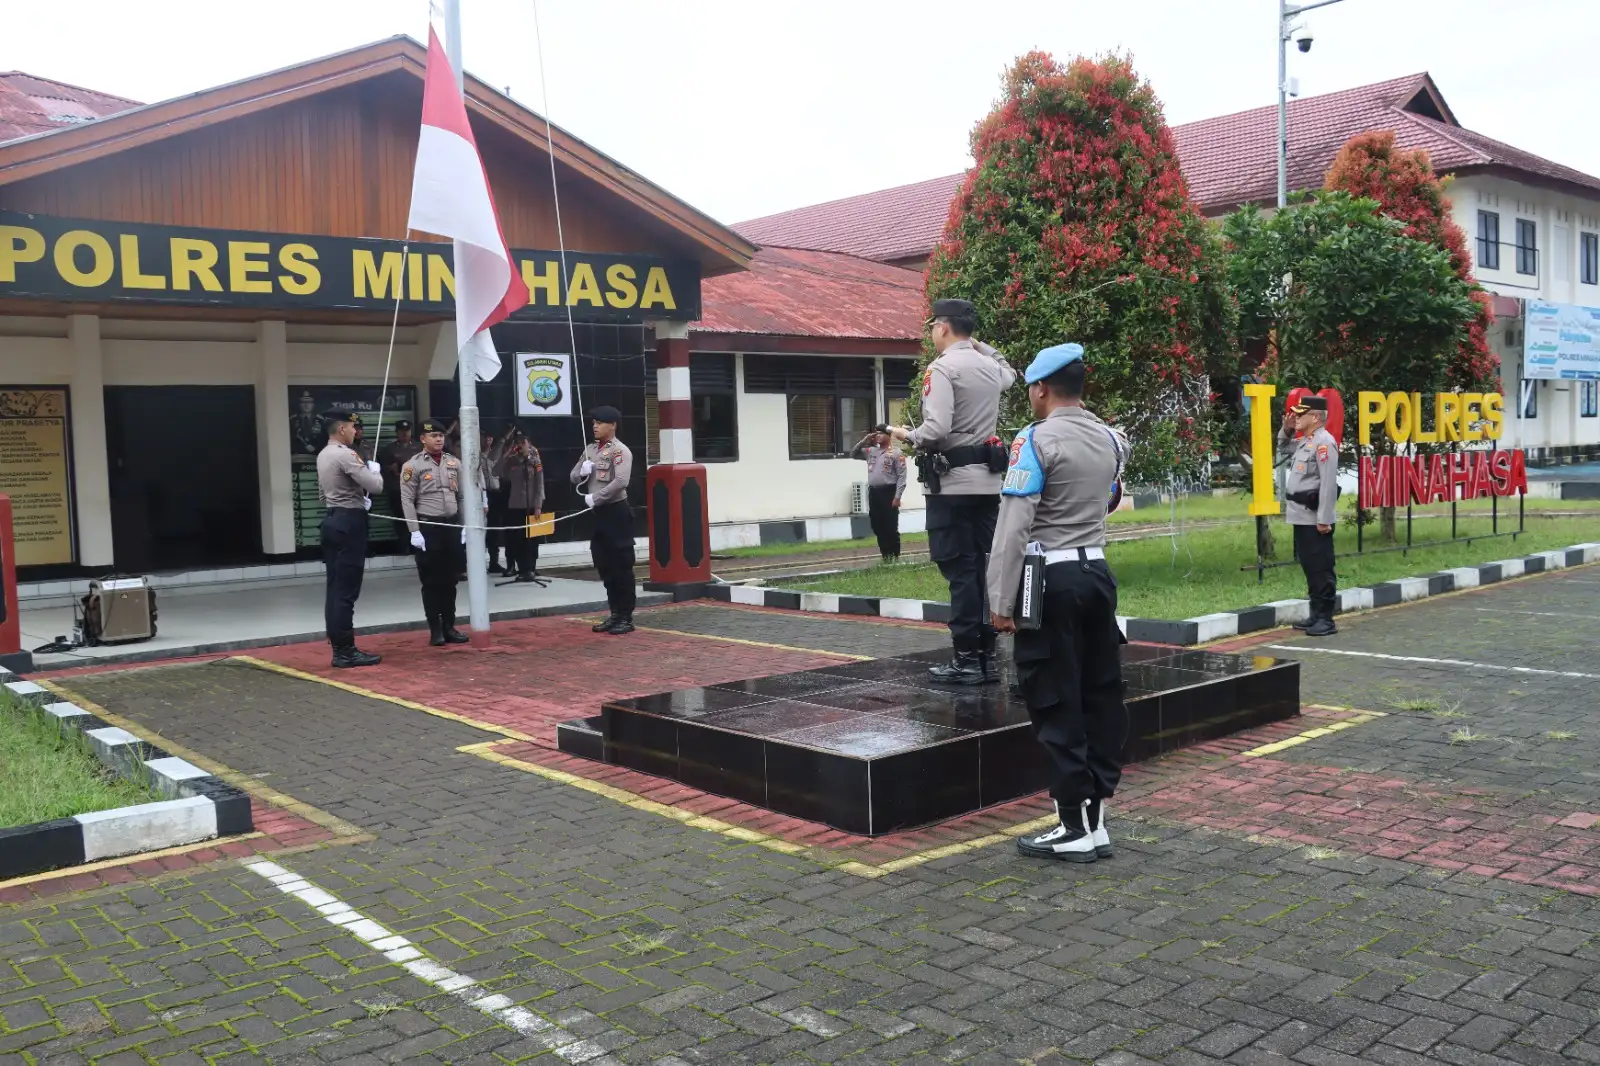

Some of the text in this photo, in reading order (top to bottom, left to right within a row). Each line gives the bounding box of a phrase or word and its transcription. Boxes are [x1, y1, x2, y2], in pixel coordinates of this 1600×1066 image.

[0, 225, 677, 310] POLRES MINHASA
[1244, 384, 1280, 516] I
[1358, 391, 1504, 446] POLRES
[1358, 448, 1528, 510] MINAHASA
